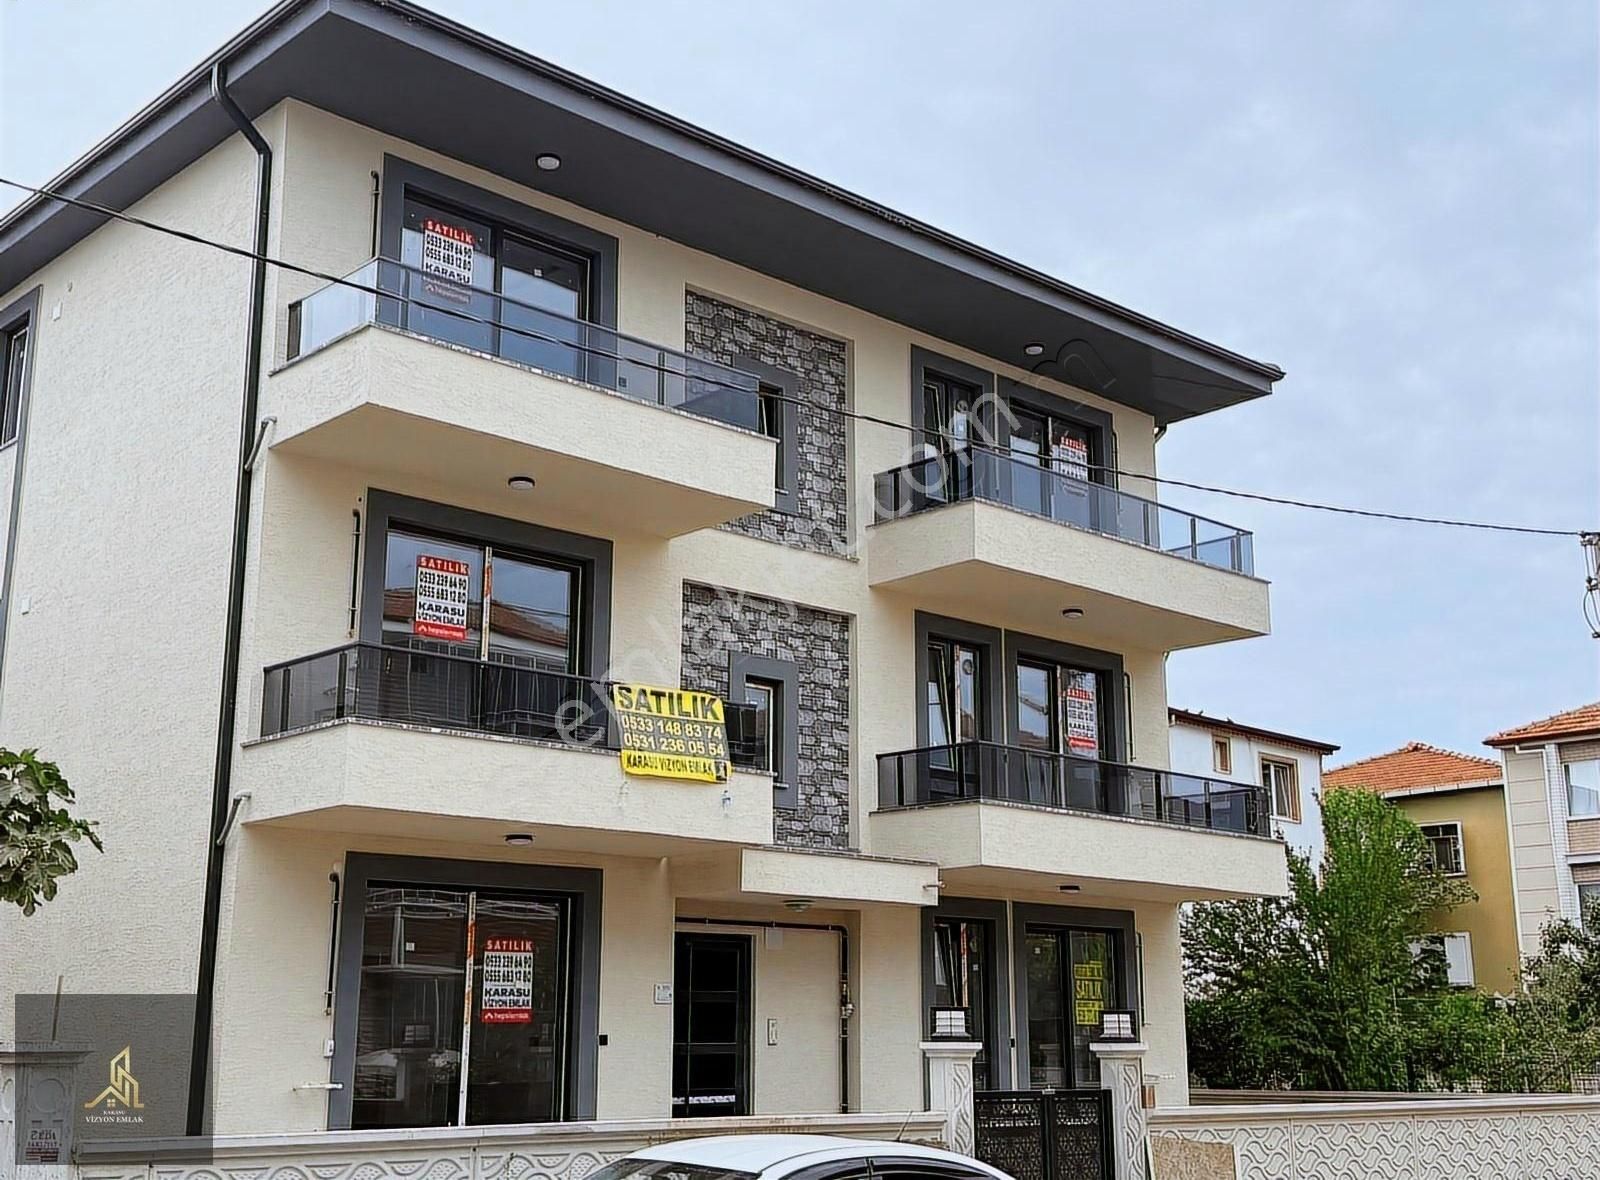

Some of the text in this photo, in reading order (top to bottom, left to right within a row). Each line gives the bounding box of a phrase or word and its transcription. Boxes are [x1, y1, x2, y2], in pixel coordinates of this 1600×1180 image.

[427, 220, 474, 244] SATILIK
[425, 261, 471, 284] KARASU
[420, 556, 468, 575] SATILIK
[418, 601, 465, 617] KARASU
[618, 686, 721, 721] SATILIK
[622, 715, 722, 740] 0533 148 83 74
[624, 732, 725, 758] 0531 236 05 54
[626, 753, 658, 770] KARASU
[487, 940, 533, 951] SATILIK
[484, 987, 531, 997] KARASU
